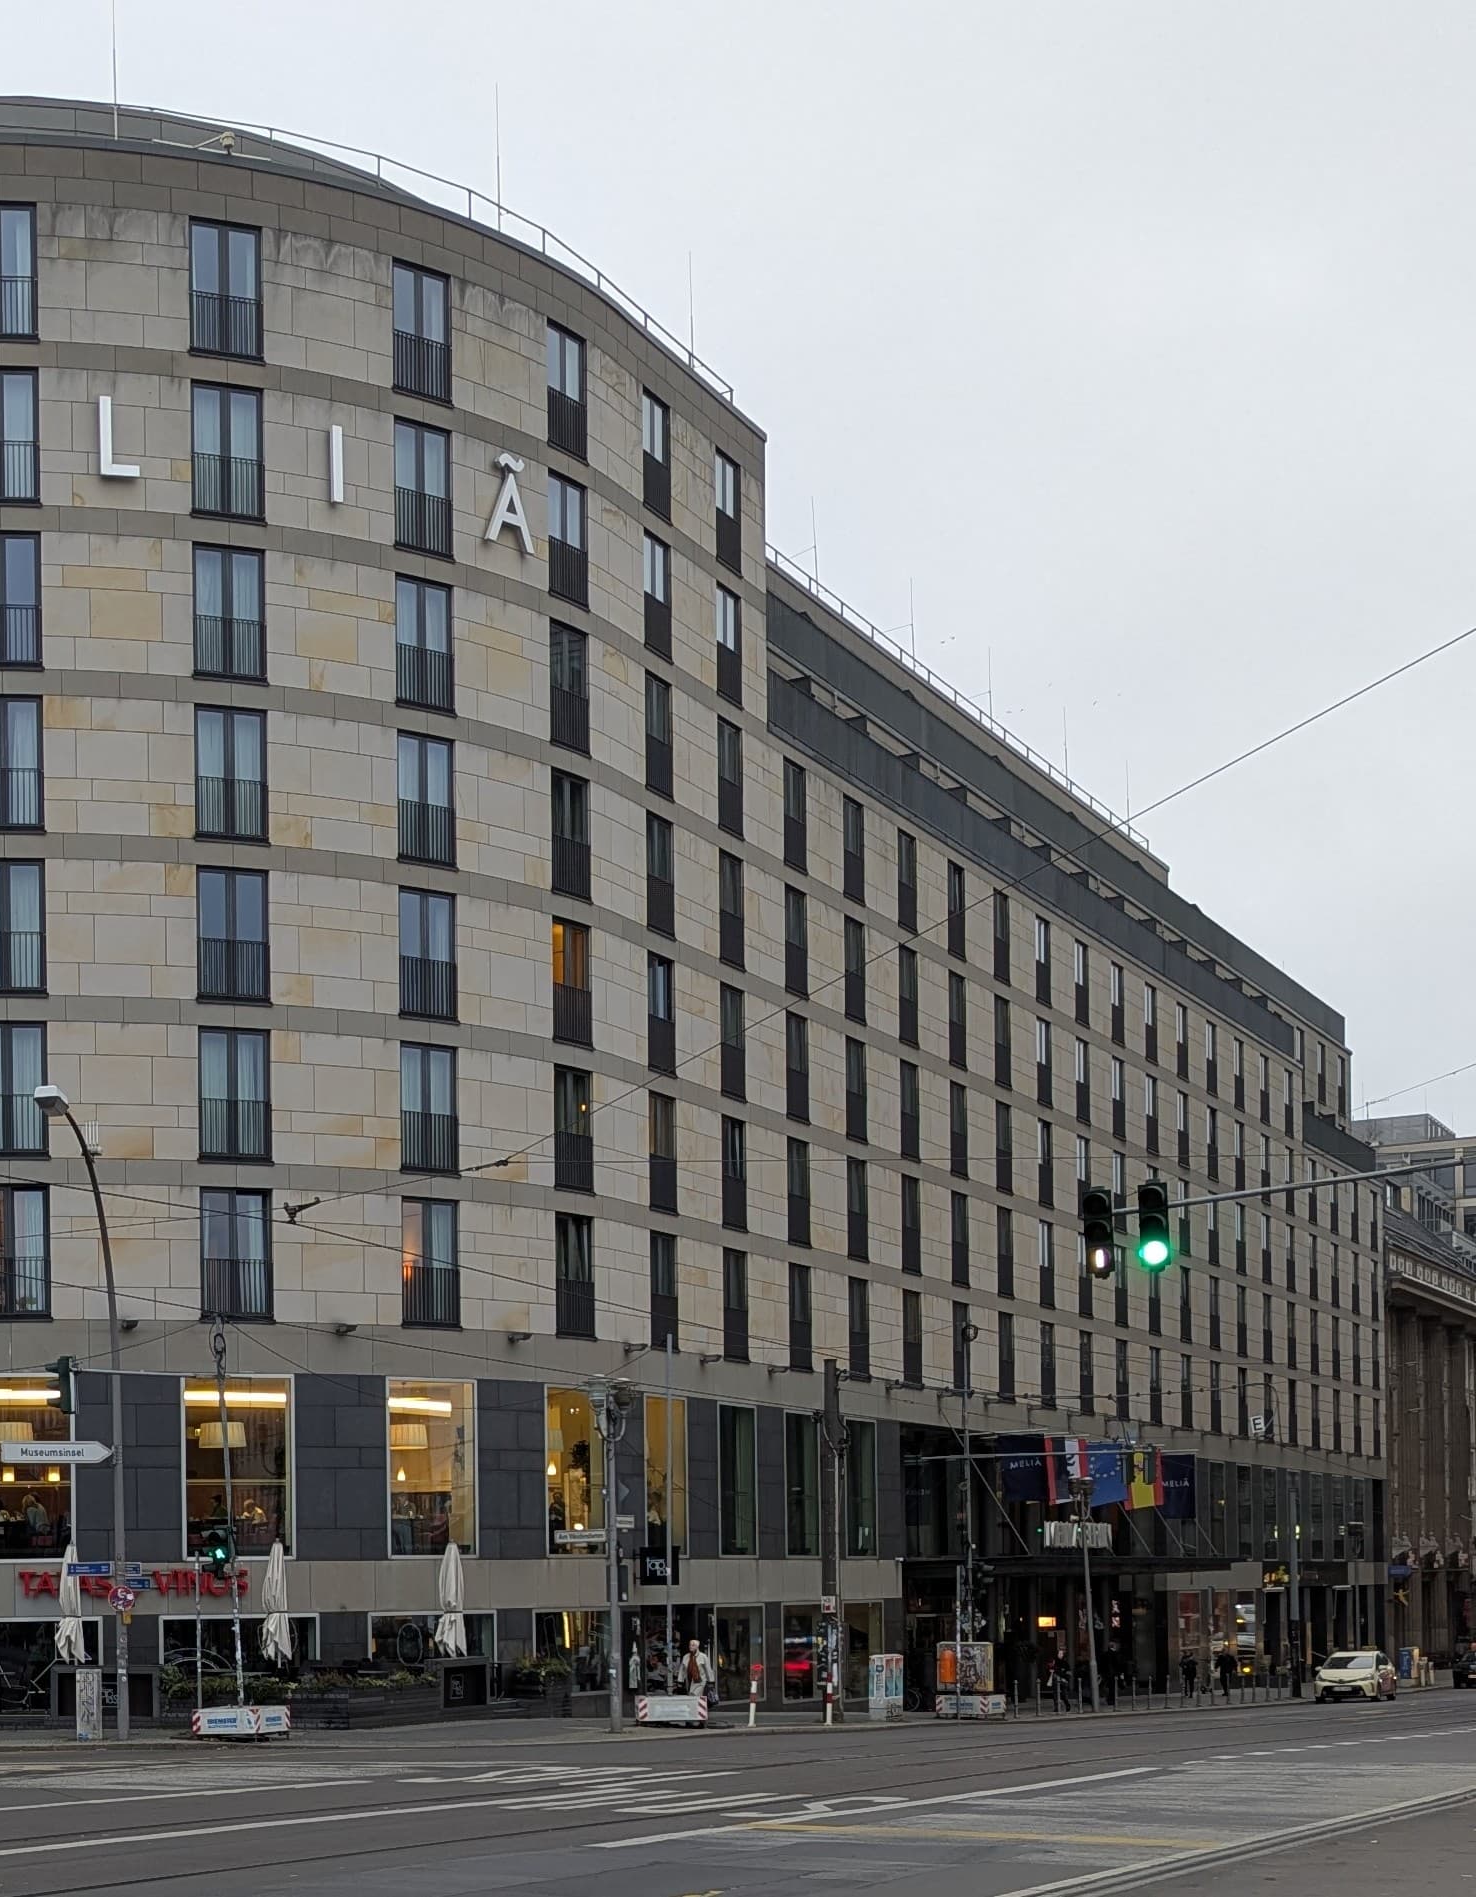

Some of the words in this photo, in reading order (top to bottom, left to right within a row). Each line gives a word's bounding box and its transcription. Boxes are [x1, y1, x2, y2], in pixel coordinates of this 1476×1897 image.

[1252, 1417, 1263, 1431] E
[20, 1447, 85, 1457] Museumsinsel
[19, 1571, 113, 1598] TAAS
